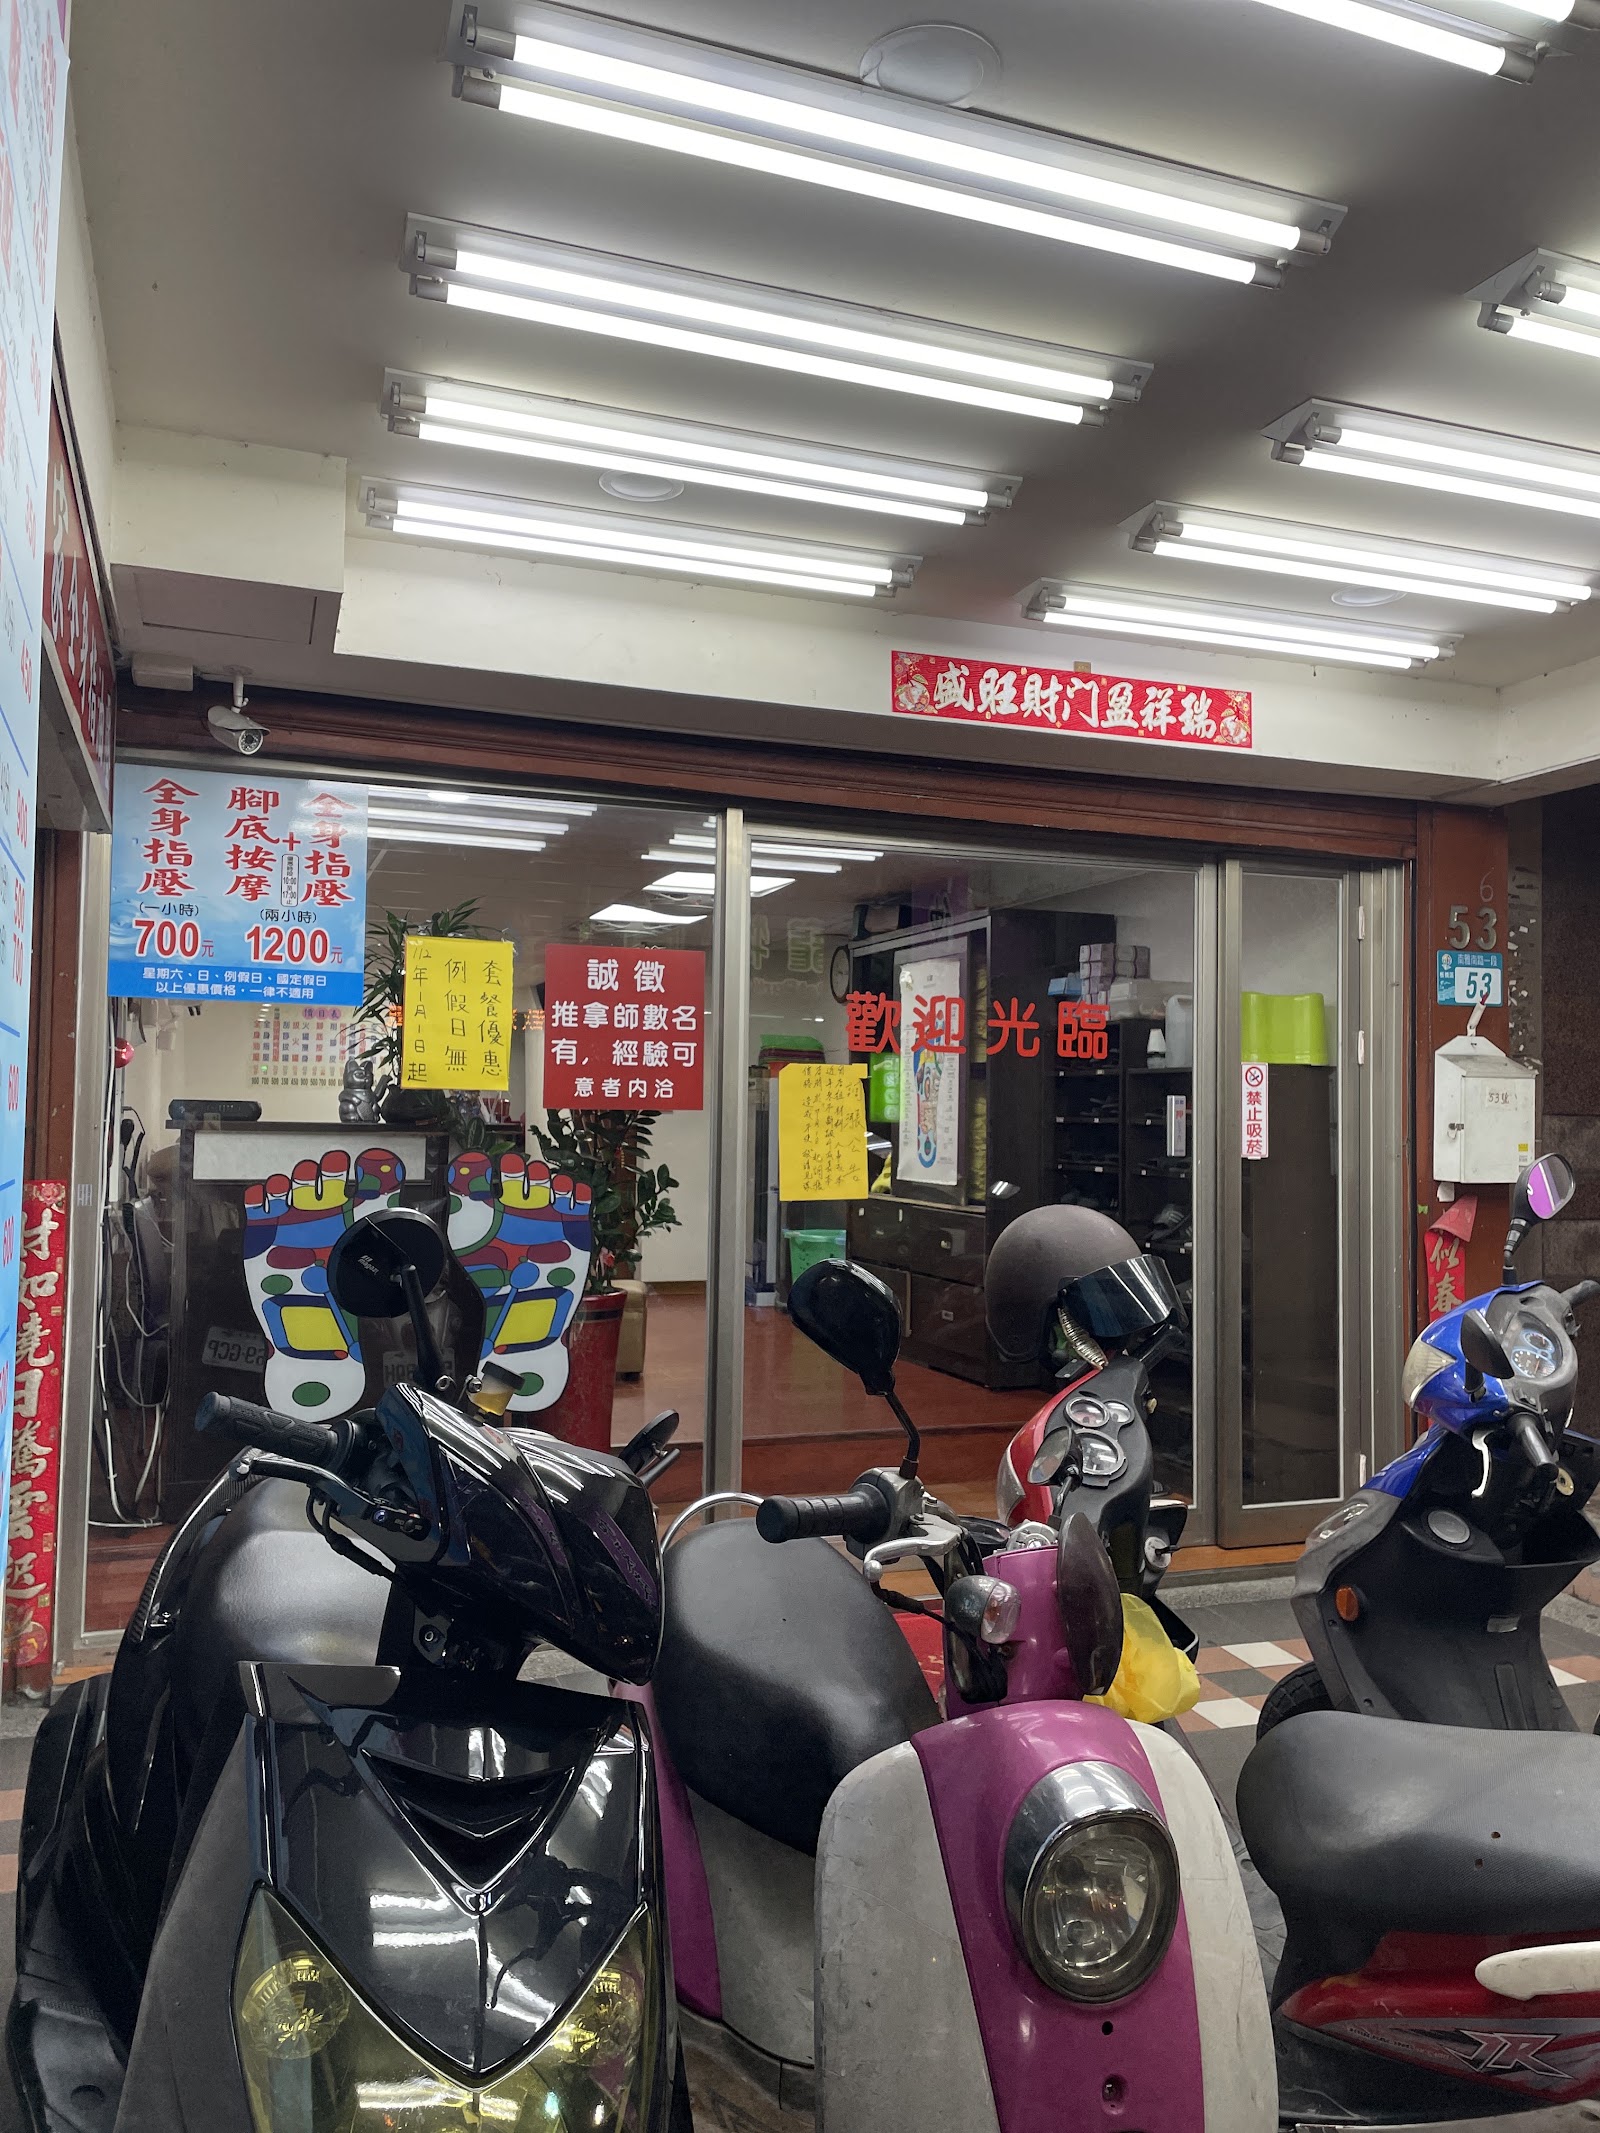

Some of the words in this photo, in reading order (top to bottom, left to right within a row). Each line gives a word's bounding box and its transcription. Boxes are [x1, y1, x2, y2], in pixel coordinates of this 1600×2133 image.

[137, 778, 200, 898] 全身指壓
[224, 786, 280, 902] 腳底按摩
[300, 791, 358, 908] 全身指壓
[1448, 905, 1498, 950] 53
[12, 932, 24, 987] 700
[587, 958, 666, 993] 誠徵
[1466, 971, 1492, 999] 53
[444, 958, 470, 1072] 例假日無
[477, 960, 505, 1077] 套餐優惠
[551, 1000, 697, 1032] 推拿師數名
[845, 990, 1110, 1060] 歡迎光臨
[574, 1077, 675, 1100] 意者內洽
